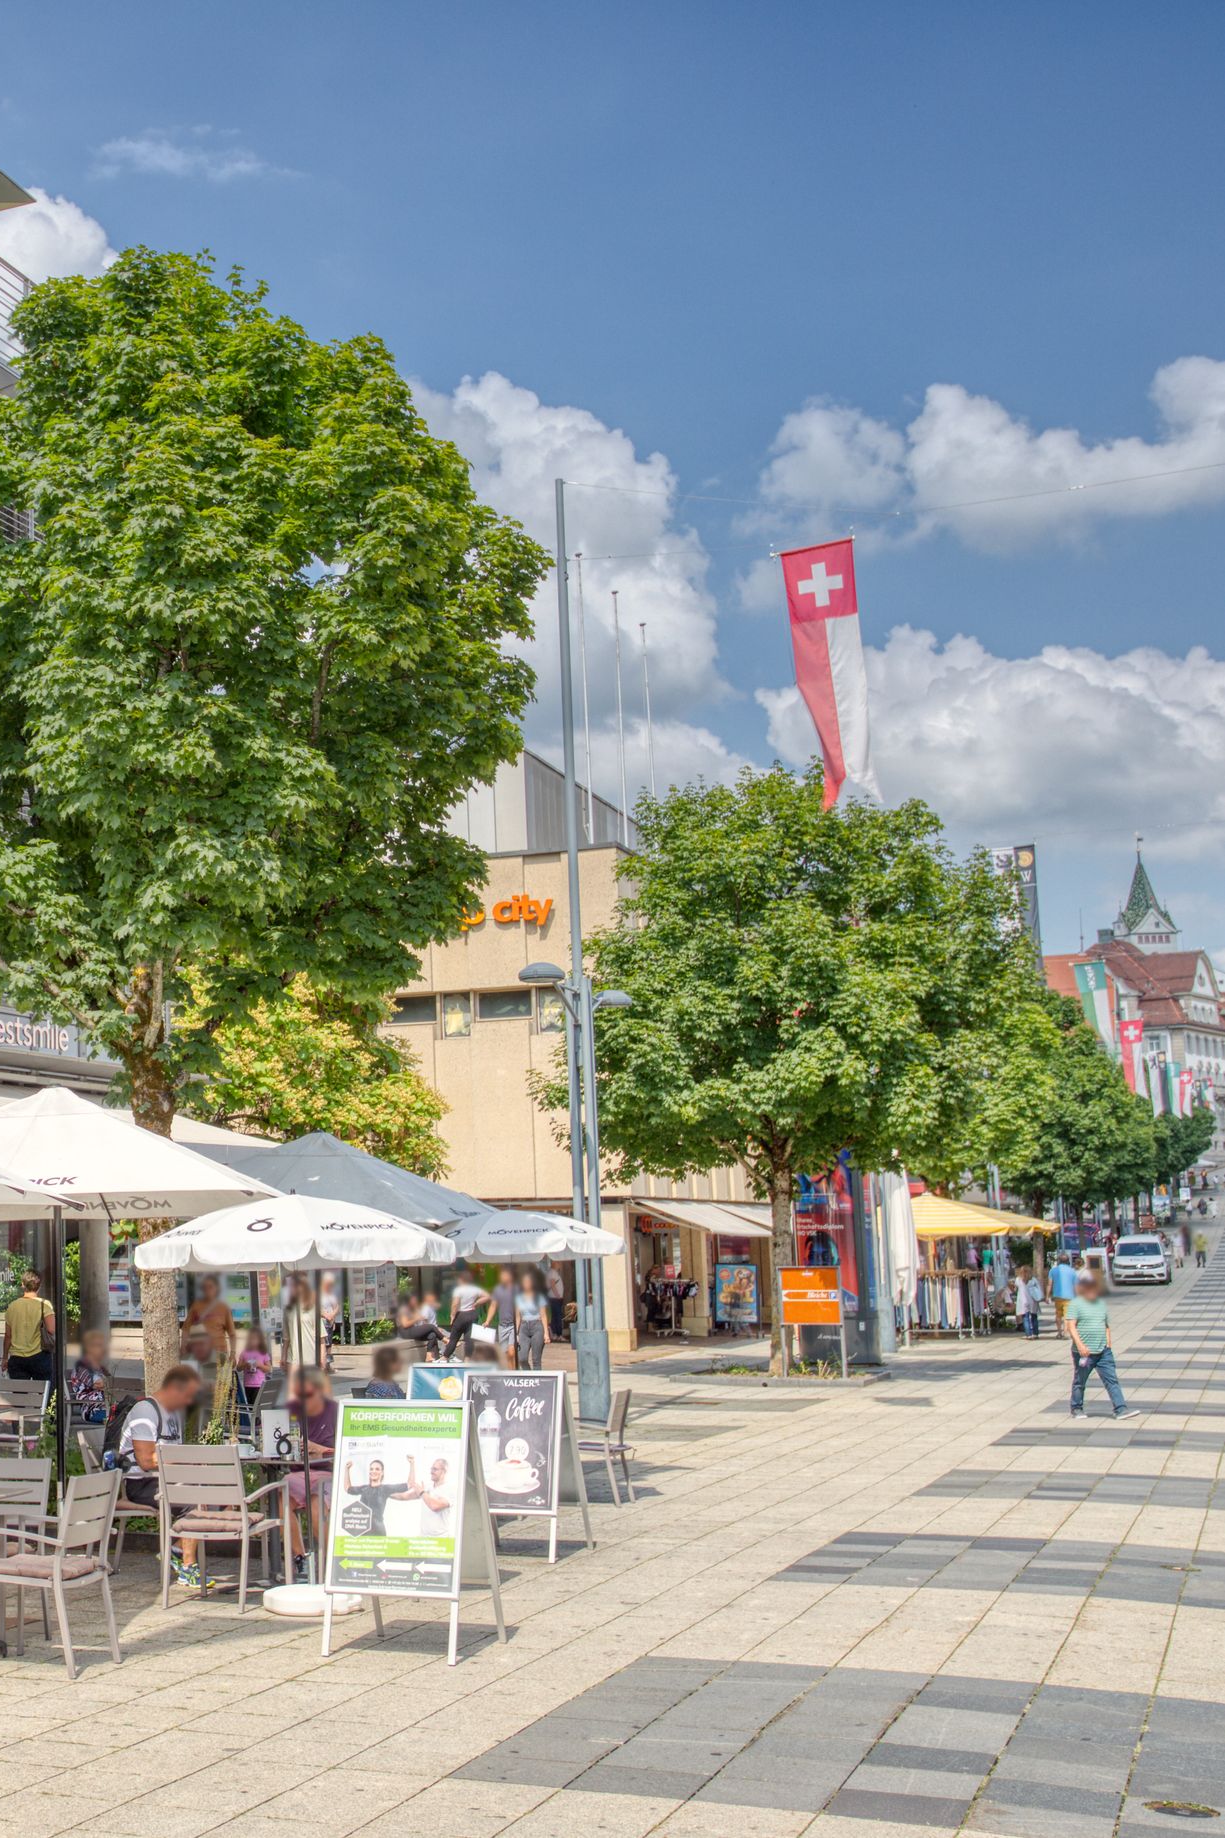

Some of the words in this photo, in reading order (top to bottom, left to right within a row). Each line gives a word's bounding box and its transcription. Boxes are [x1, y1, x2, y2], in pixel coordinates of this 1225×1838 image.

[492, 894, 553, 926] city
[503, 1379, 534, 1388] VALSER
[350, 1410, 435, 1422] KÖRPERFORMEN
[437, 1412, 457, 1422] WIL
[350, 1423, 361, 1431] Ihr
[362, 1424, 379, 1432] EMS
